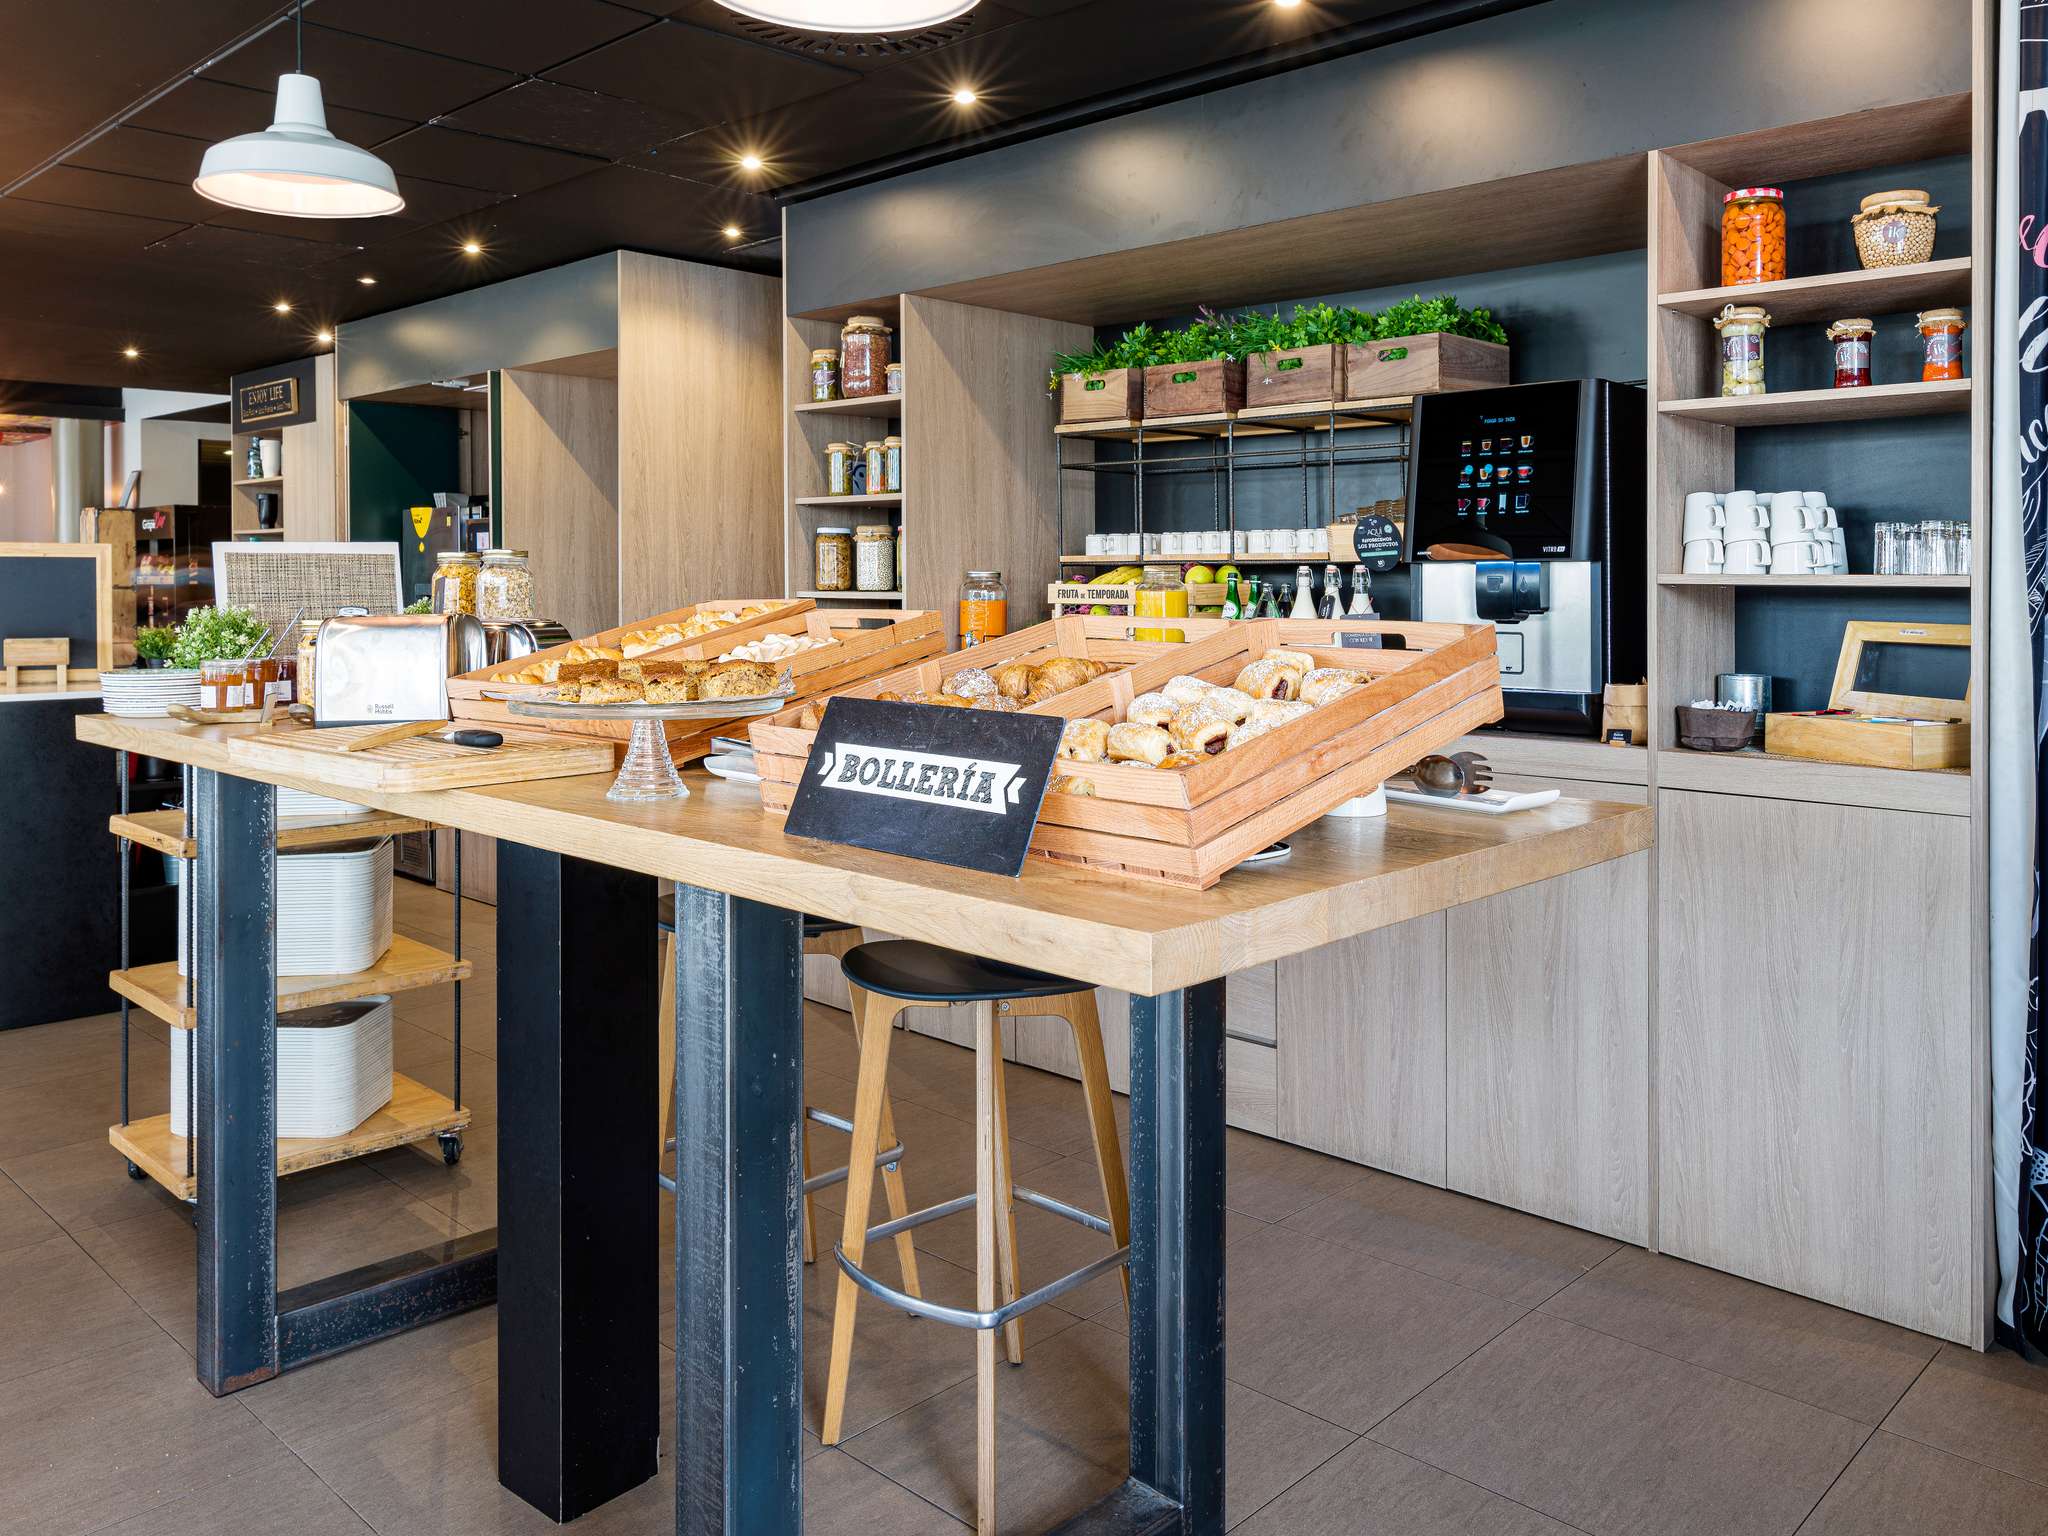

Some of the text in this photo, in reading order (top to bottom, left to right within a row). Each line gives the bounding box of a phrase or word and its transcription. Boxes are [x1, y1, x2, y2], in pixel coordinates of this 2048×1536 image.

[248, 385, 285, 405] ENJOY LIFE
[1367, 526, 1383, 537] AQUÍ
[1368, 541, 1399, 549] PRODUCTOS
[1057, 589, 1079, 599] FRUTA
[1087, 589, 1130, 600] TEMPORADA
[837, 752, 997, 805] BOLLERÍA
